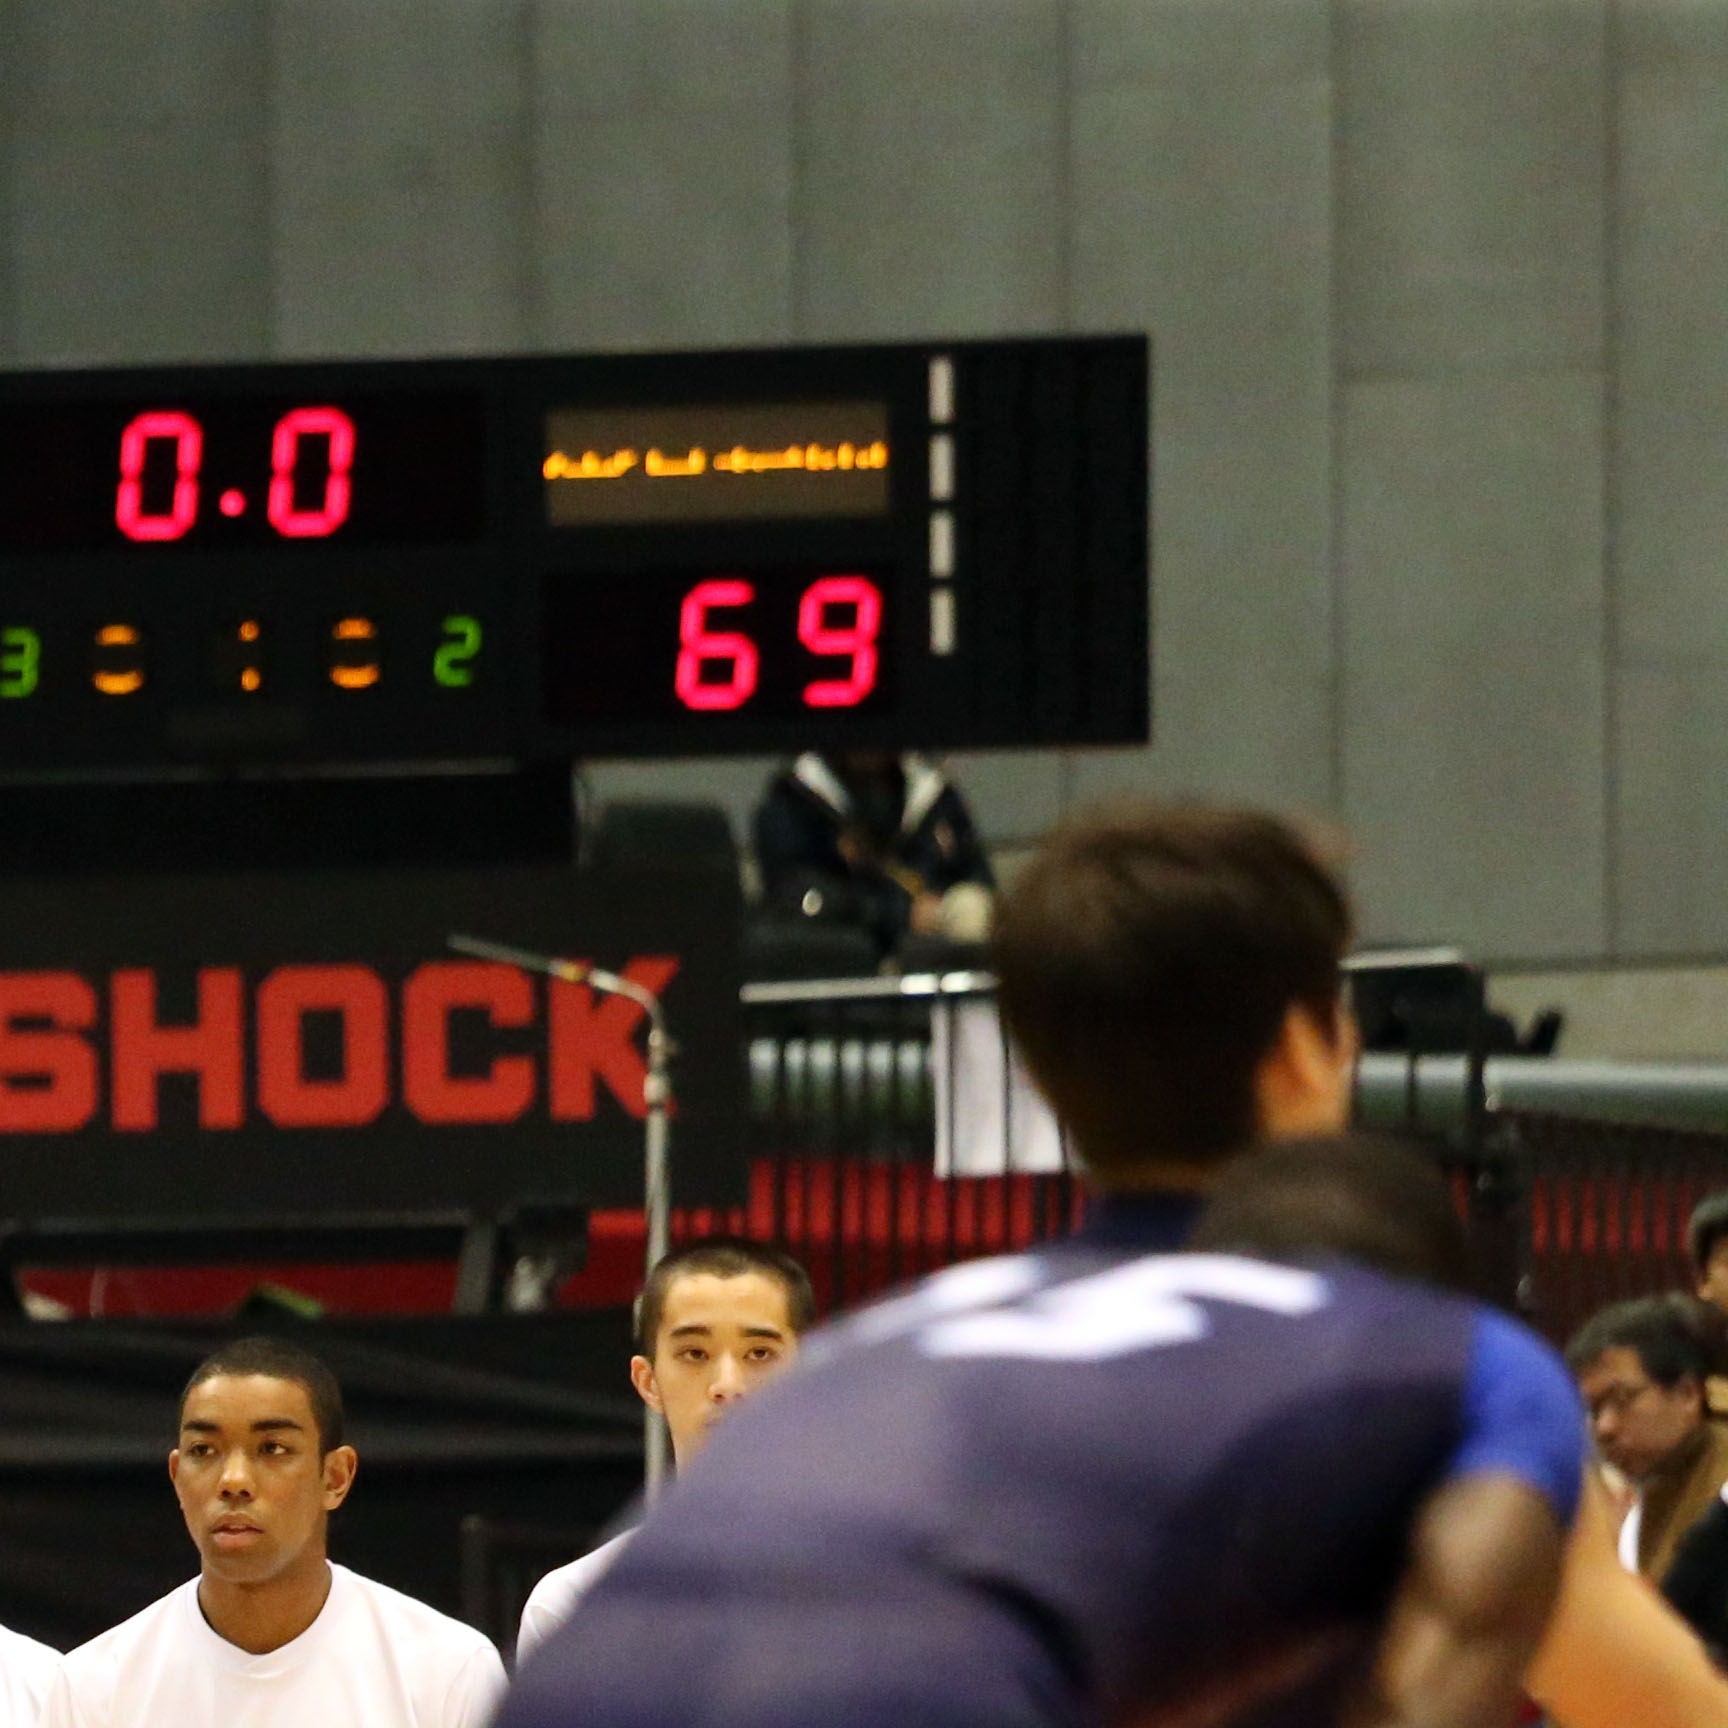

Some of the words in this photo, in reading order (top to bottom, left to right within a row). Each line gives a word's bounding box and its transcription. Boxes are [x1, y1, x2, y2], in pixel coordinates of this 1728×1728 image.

[115, 406, 356, 542] 0.0
[433, 615, 482, 687] 2
[675, 575, 884, 711] 69
